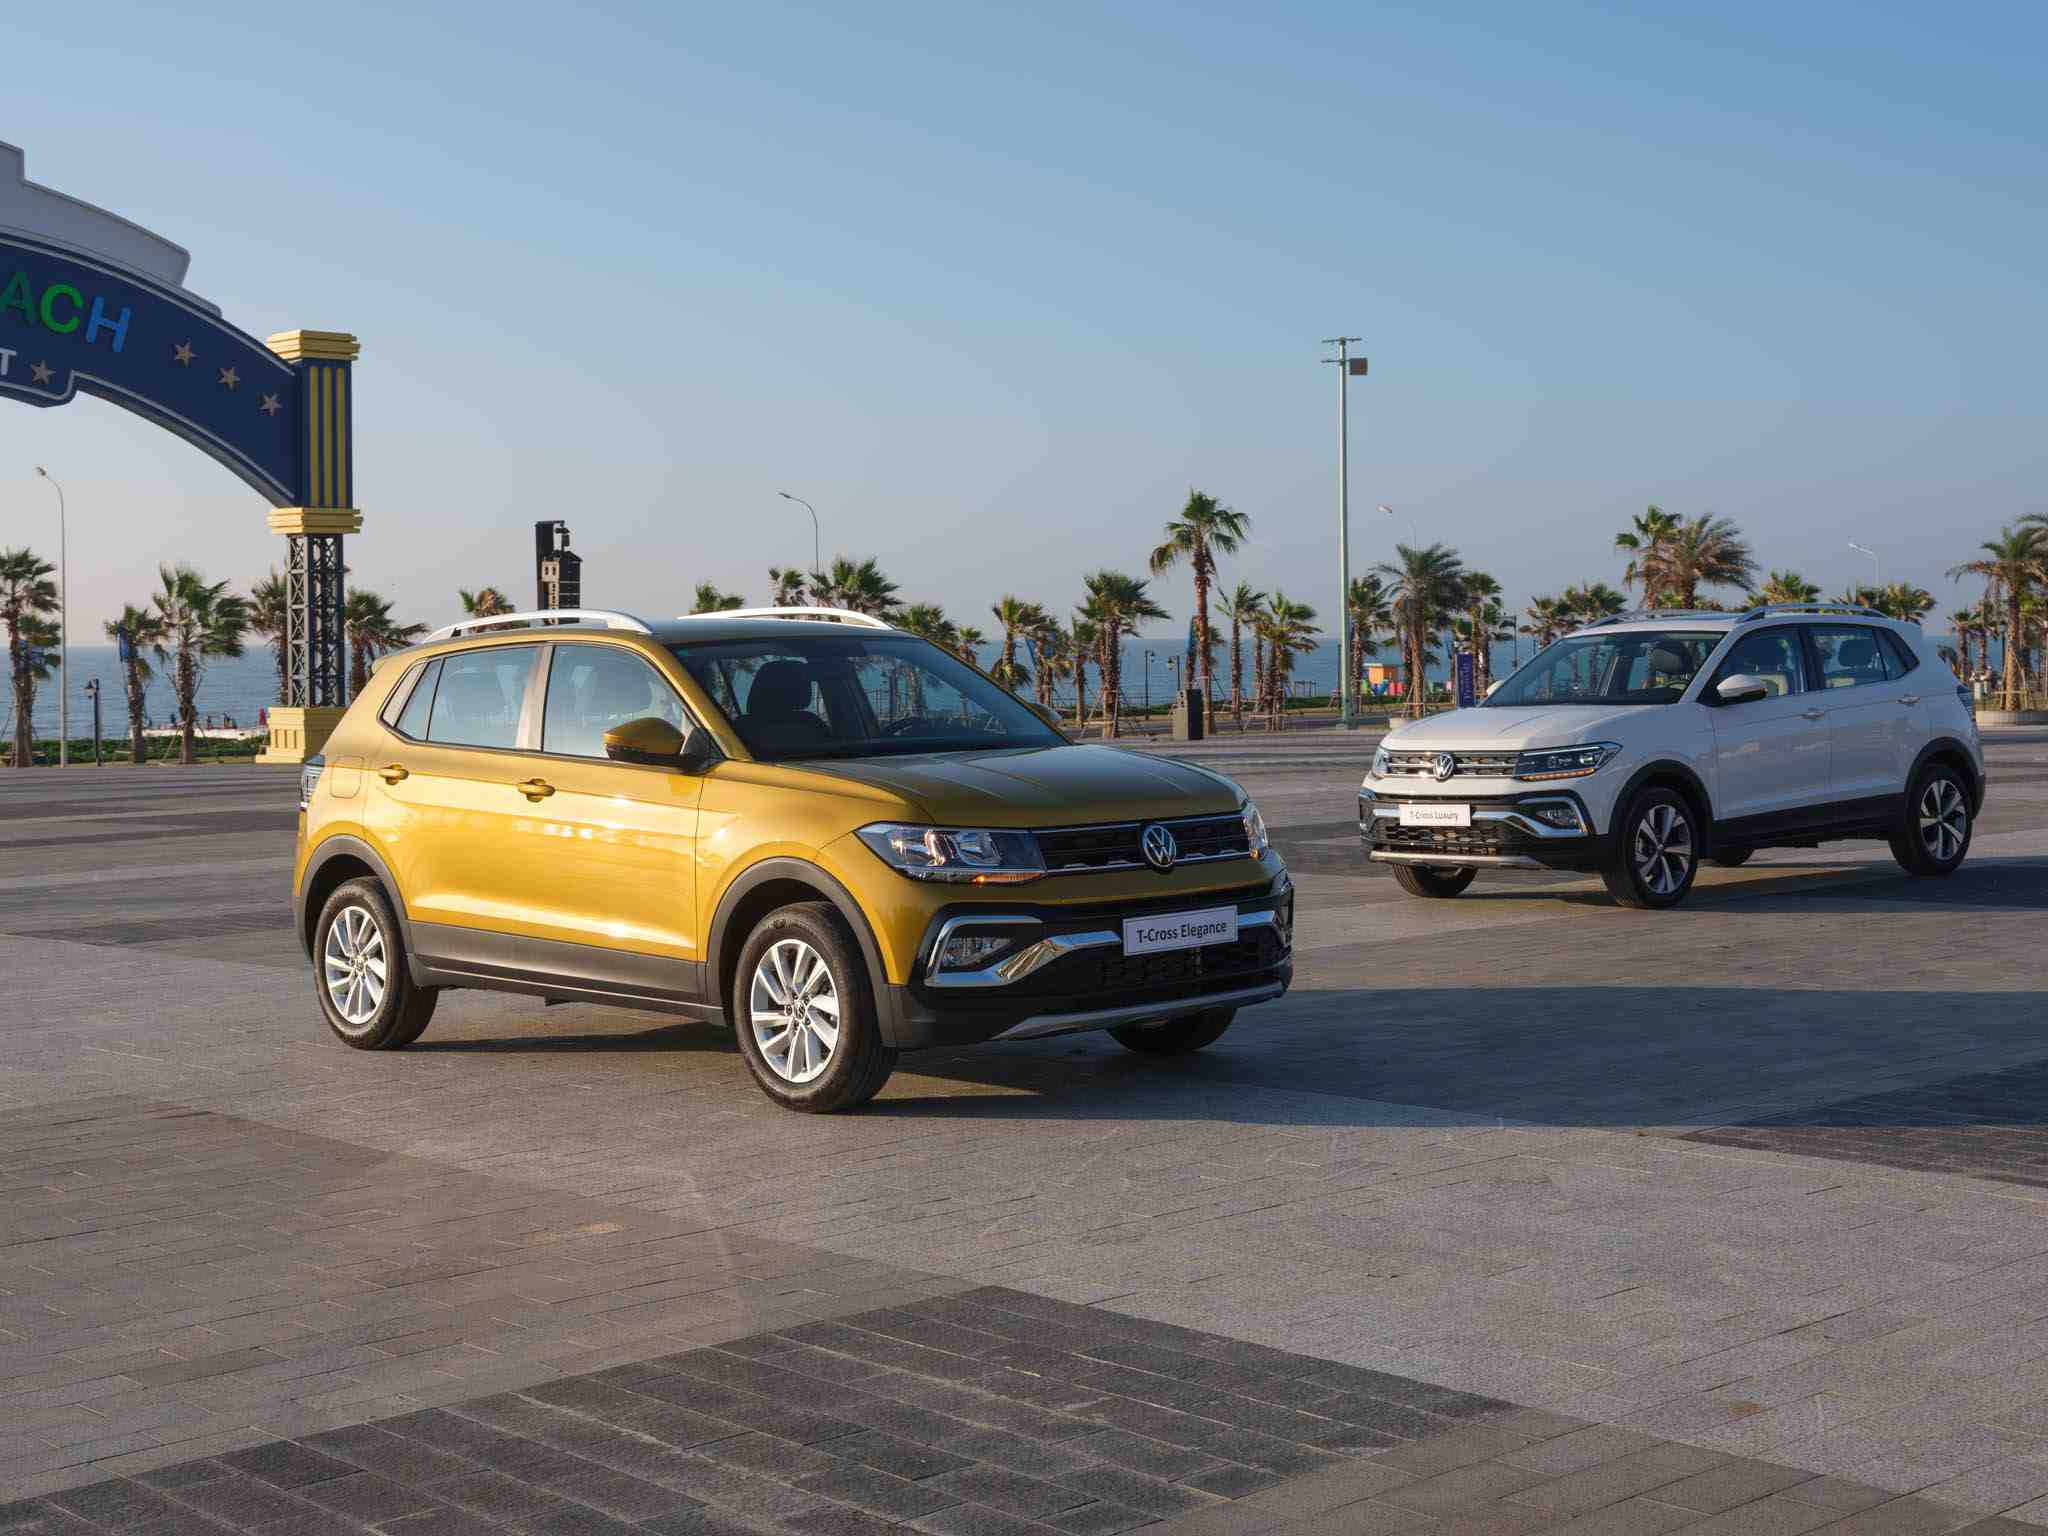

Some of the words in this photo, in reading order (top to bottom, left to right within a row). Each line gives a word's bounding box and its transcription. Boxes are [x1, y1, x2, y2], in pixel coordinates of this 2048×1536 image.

[0, 271, 131, 353] ACH
[1136, 928, 1178, 943] T-Cross
[1181, 921, 1227, 939] Elegance
